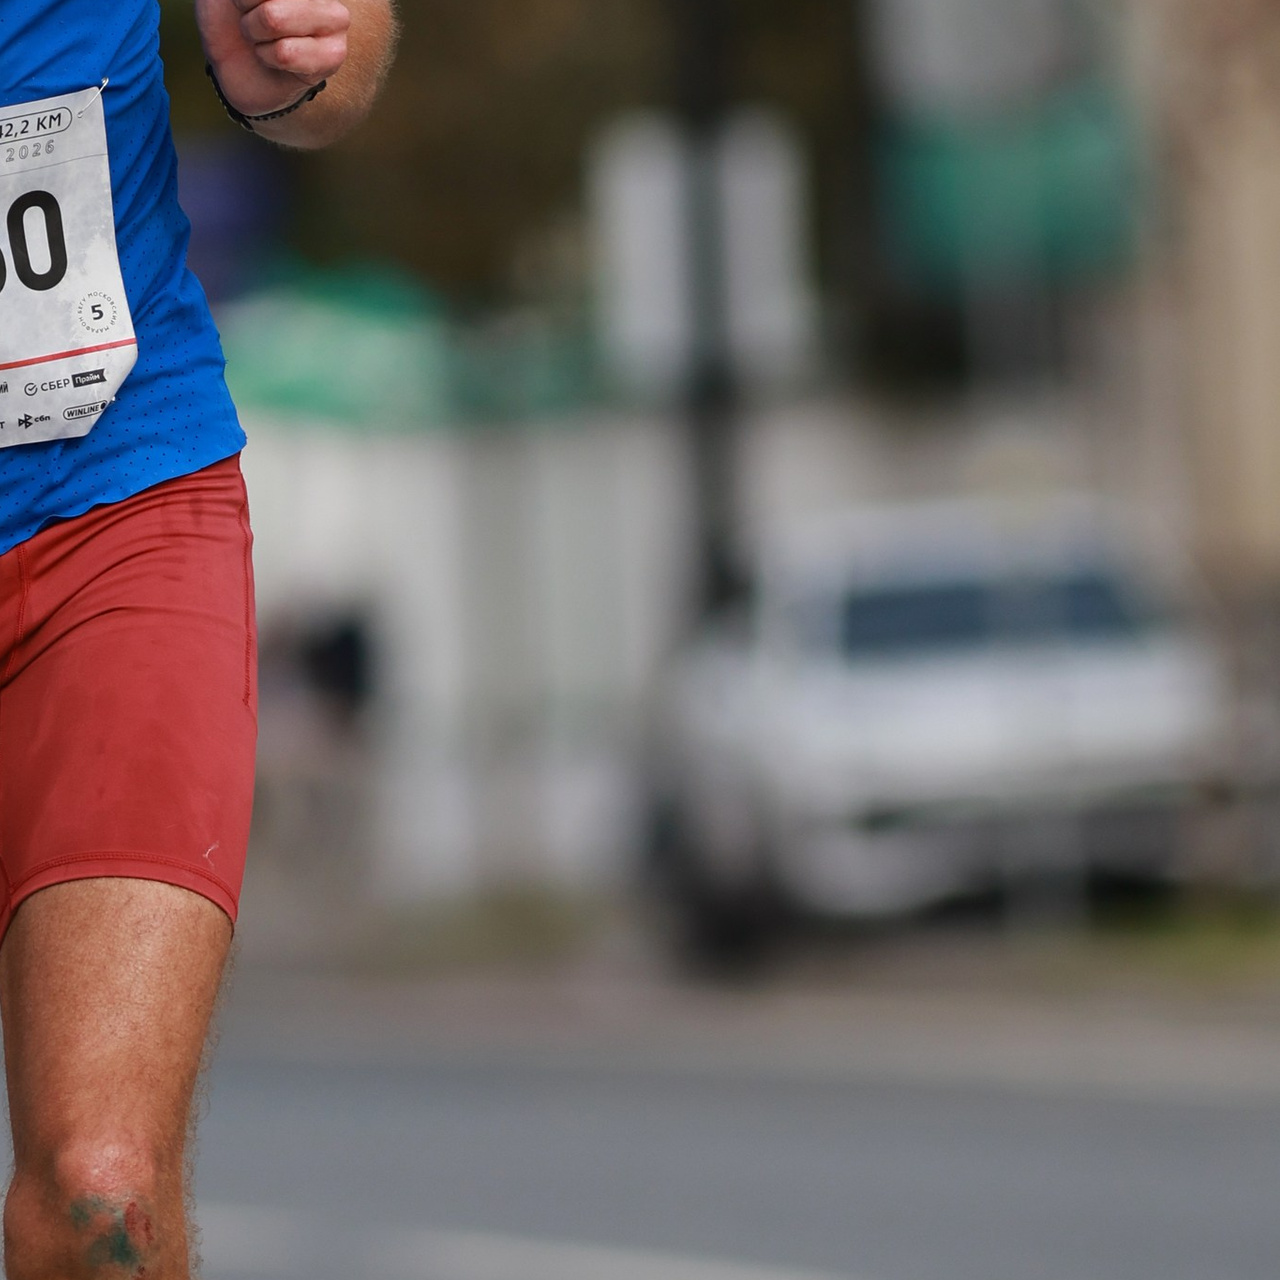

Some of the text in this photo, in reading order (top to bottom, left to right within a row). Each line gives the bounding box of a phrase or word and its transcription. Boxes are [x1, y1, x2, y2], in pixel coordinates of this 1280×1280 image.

[36, 112, 62, 131] КМ
[5, 139, 55, 163] 2026
[91, 304, 104, 320] 5
[40, 373, 101, 392] СБЕР Прайм
[67, 405, 100, 418] WINLINE
